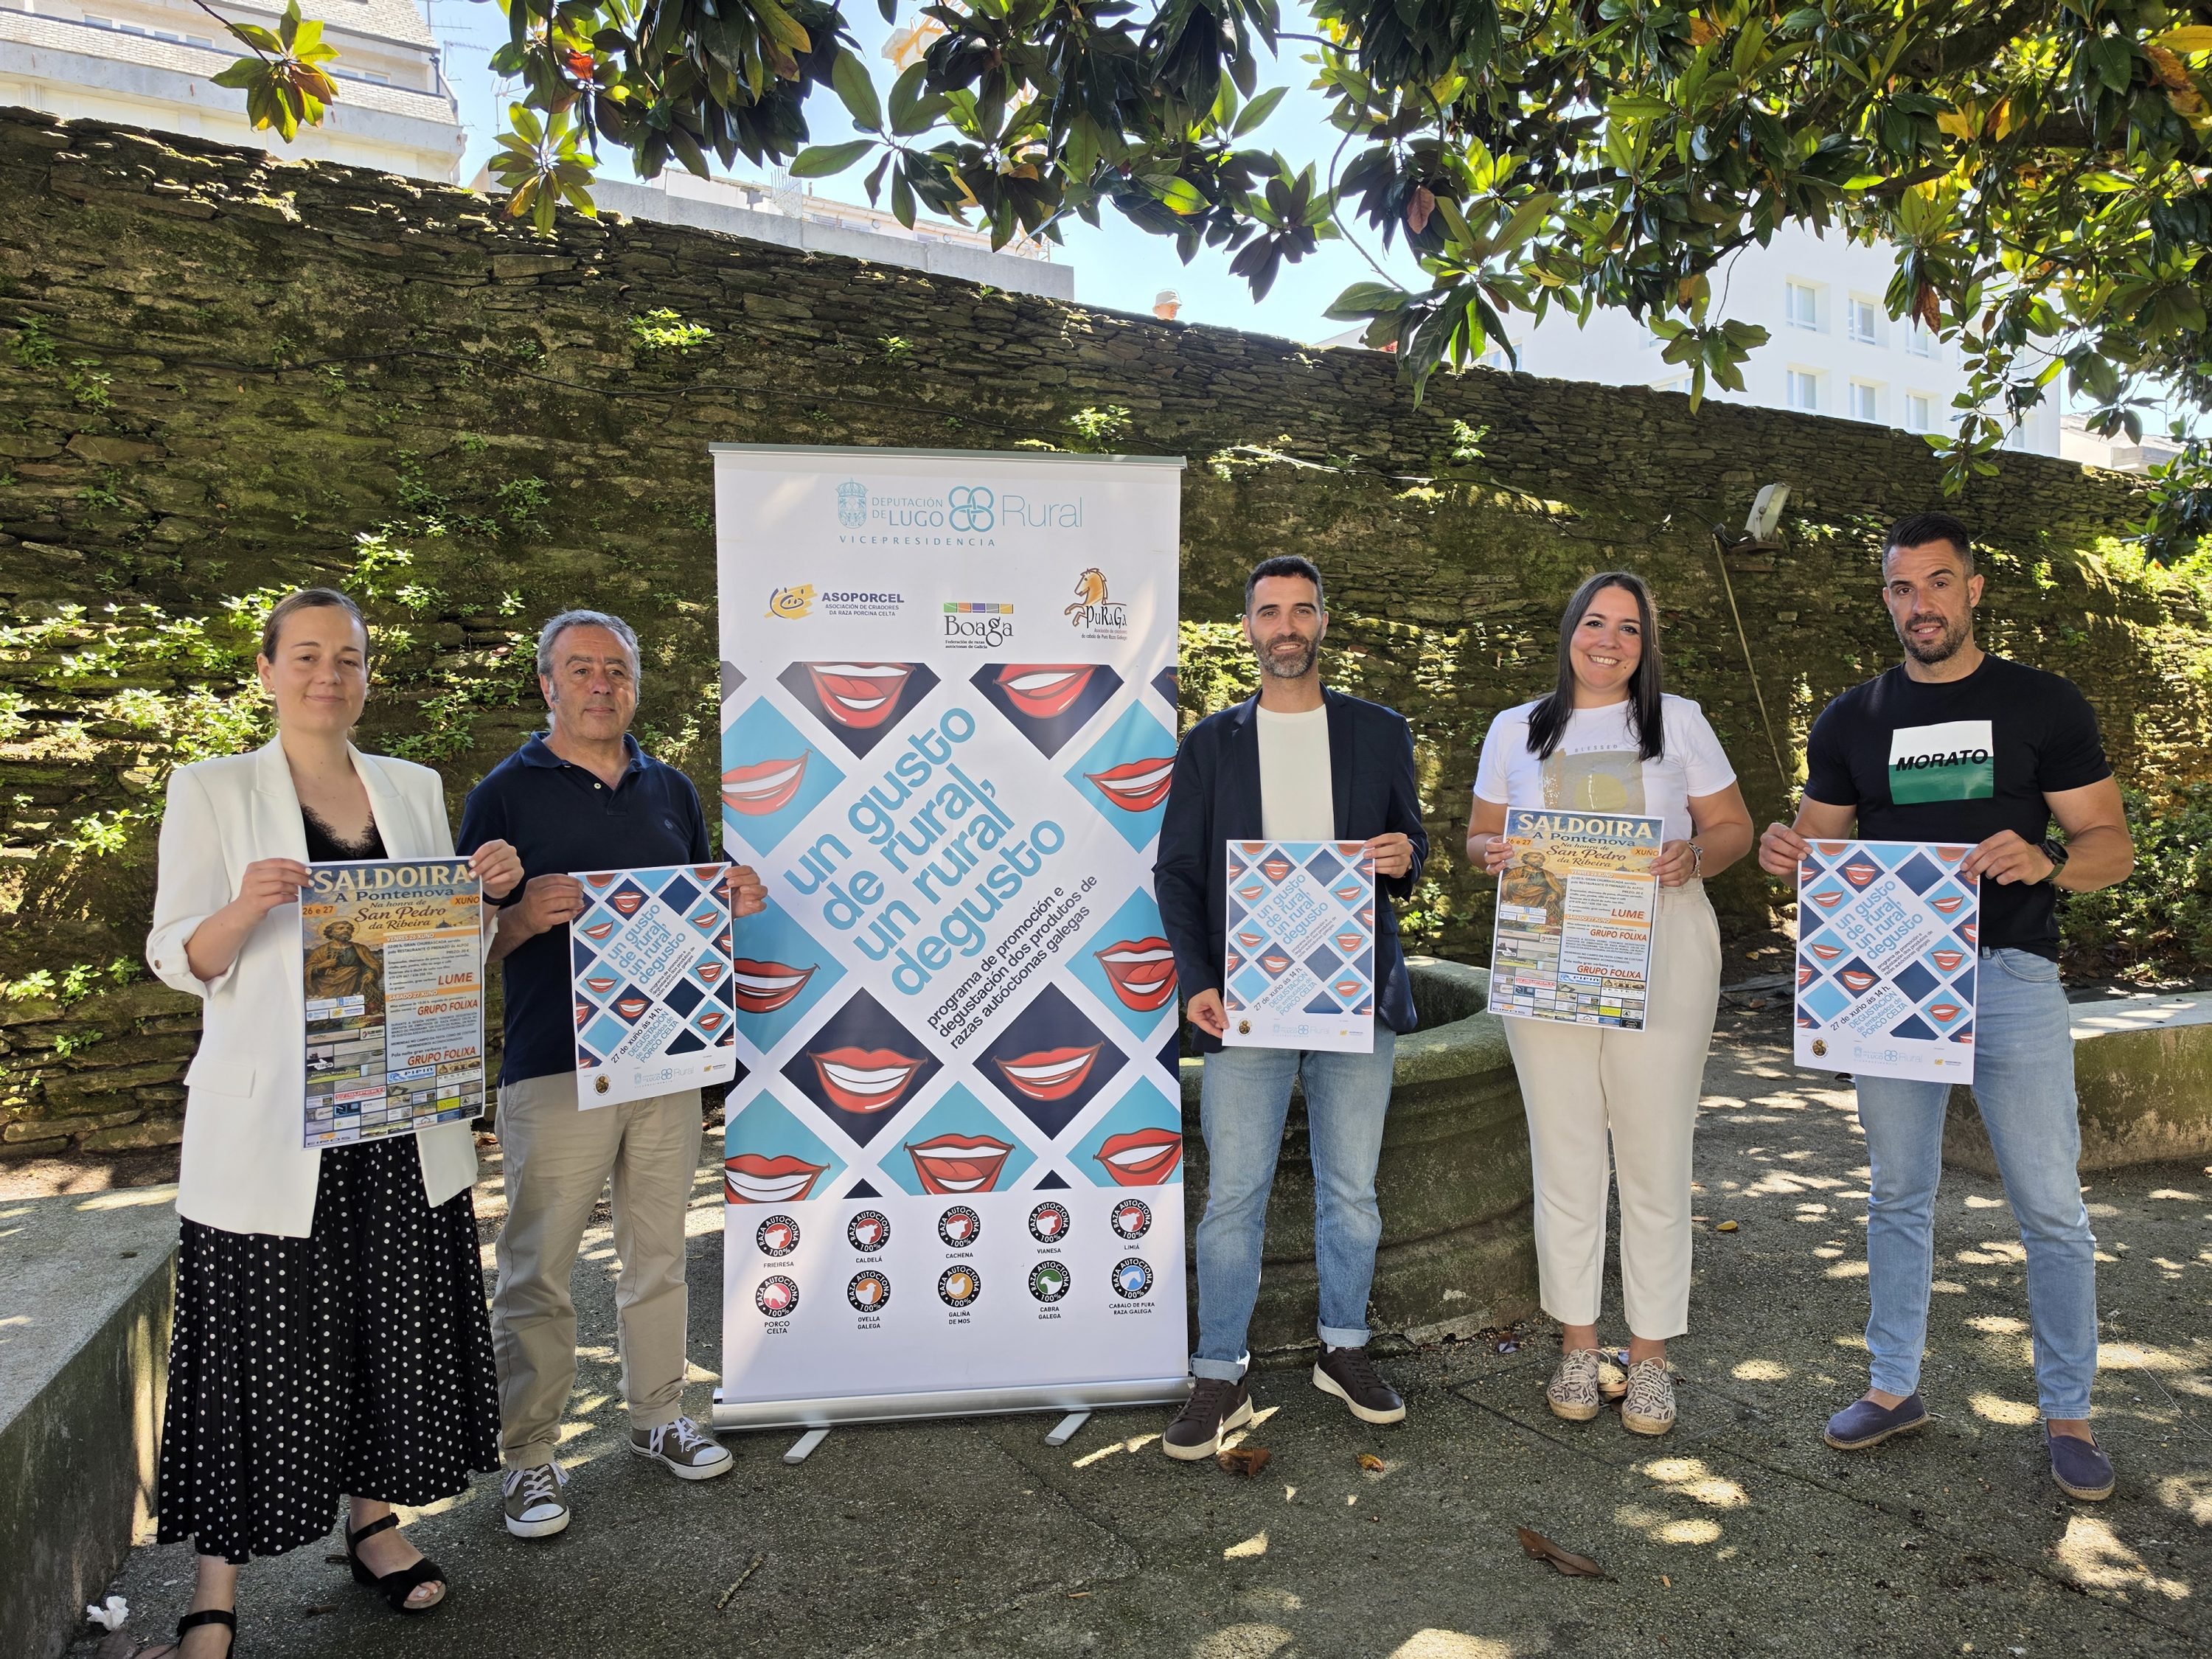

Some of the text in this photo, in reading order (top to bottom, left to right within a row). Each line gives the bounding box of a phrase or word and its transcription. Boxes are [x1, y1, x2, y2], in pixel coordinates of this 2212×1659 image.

[872, 496, 943, 508] DEPUTACIÓN
[1002, 495, 1082, 527] Rural
[872, 509, 944, 528] DE LUGO
[839, 535, 995, 546] VICEPRESIDENCIA
[821, 592, 904, 603] ASOPORCEL
[944, 615, 1014, 647] Boaga
[1574, 744, 1618, 753] BLESSED
[1896, 748, 1989, 771] MORATO
[783, 707, 975, 894] un gusto
[1517, 813, 1653, 839] SALDOIRA
[823, 763, 996, 931] de rural,
[1551, 832, 1635, 846] Pontenova
[1546, 845, 1627, 861] San Pedro
[1635, 848, 1659, 857] XUÑO
[1572, 858, 1612, 868] Ribeira
[314, 864, 473, 894] SALDOIRA
[852, 793, 1015, 961] un rural
[334, 888, 455, 902] A Pontenova
[455, 896, 479, 905] XUÑO
[1257, 874, 1306, 919] un gusto
[323, 905, 334, 914] 27
[354, 906, 446, 922] San Pedro
[891, 820, 1065, 995] degusto
[1611, 908, 1645, 919] LUME
[1835, 880, 1896, 930] un gusto
[369, 919, 431, 930] da Ribeira
[1266, 914, 1281, 928] de
[1273, 895, 1315, 936] un rural
[1283, 902, 1328, 945] degusto
[608, 905, 660, 960] un gusto
[1590, 929, 1647, 942] GRUPO FOLIXA
[1846, 924, 1865, 940] de
[1855, 905, 1907, 950] un rural
[1866, 914, 1923, 960] degusto
[619, 951, 636, 968] de
[627, 928, 672, 975] un rural
[639, 933, 686, 984] degusto
[927, 886, 1064, 1030] programa de promoción e
[939, 876, 1097, 1037] degustación dos produtos de
[438, 972, 473, 986] LUME
[950, 905, 1091, 1050] razas autóctonas galegas
[1576, 965, 1608, 975] GRUPO
[1610, 969, 1641, 979] FOLIXA
[417, 1004, 448, 1015] GRUPO
[449, 999, 479, 1011] FOLIXA
[1830, 1022, 1840, 1031] 27
[1840, 1015, 1850, 1024] de
[1874, 990, 1883, 998] 14
[407, 1046, 476, 1066] GRUPO FOLIXA
[939, 1217, 948, 1237] RAZA
[1030, 1213, 1038, 1231] RAZA
[1113, 1210, 1121, 1228] RAZA
[758, 1227, 767, 1246] RAZA
[849, 1222, 858, 1240] RAZA
[1040, 1234, 1061, 1242] 100%
[1122, 1231, 1143, 1239] 100%
[769, 1247, 790, 1256] 100%
[860, 1243, 881, 1251] 100%
[950, 1238, 971, 1247] 100%
[939, 1277, 948, 1296] RAZA
[1030, 1273, 1038, 1291] RAZA
[1113, 1269, 1121, 1287] RAZA
[757, 1287, 765, 1307] RAZA
[849, 1281, 858, 1301] RAZA
[1040, 1293, 1062, 1302] 100%
[1123, 1290, 1144, 1298] 100%
[860, 1303, 881, 1312] 100%
[950, 1298, 972, 1307] 100%
[768, 1308, 790, 1317] 100%
[948, 1310, 970, 1318] GALIÑA
